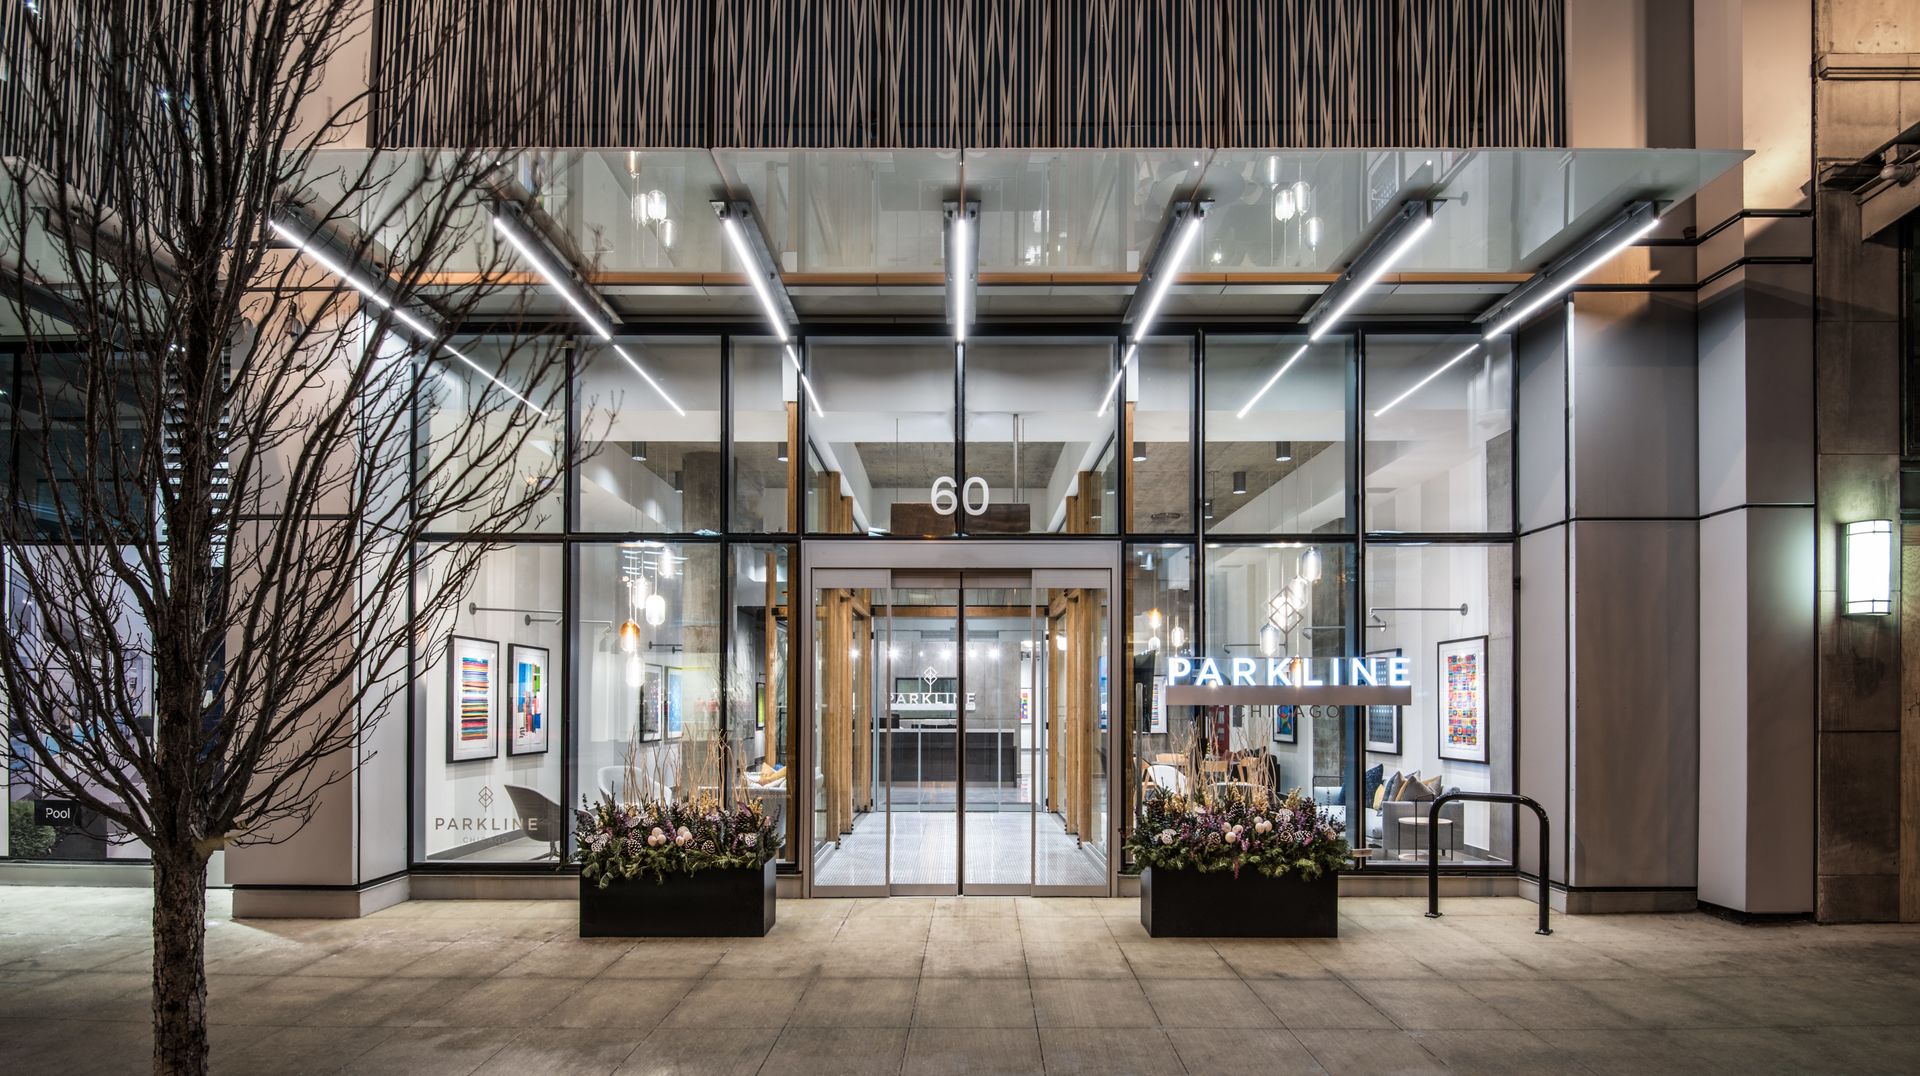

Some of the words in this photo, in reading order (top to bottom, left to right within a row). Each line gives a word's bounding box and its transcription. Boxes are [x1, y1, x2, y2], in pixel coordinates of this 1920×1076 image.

[931, 476, 989, 516] 60
[1167, 657, 1411, 686] PARKLINE
[1235, 704, 1339, 718] CHICAGO
[45, 807, 70, 819] Pool
[435, 817, 539, 831] PARKLINE
